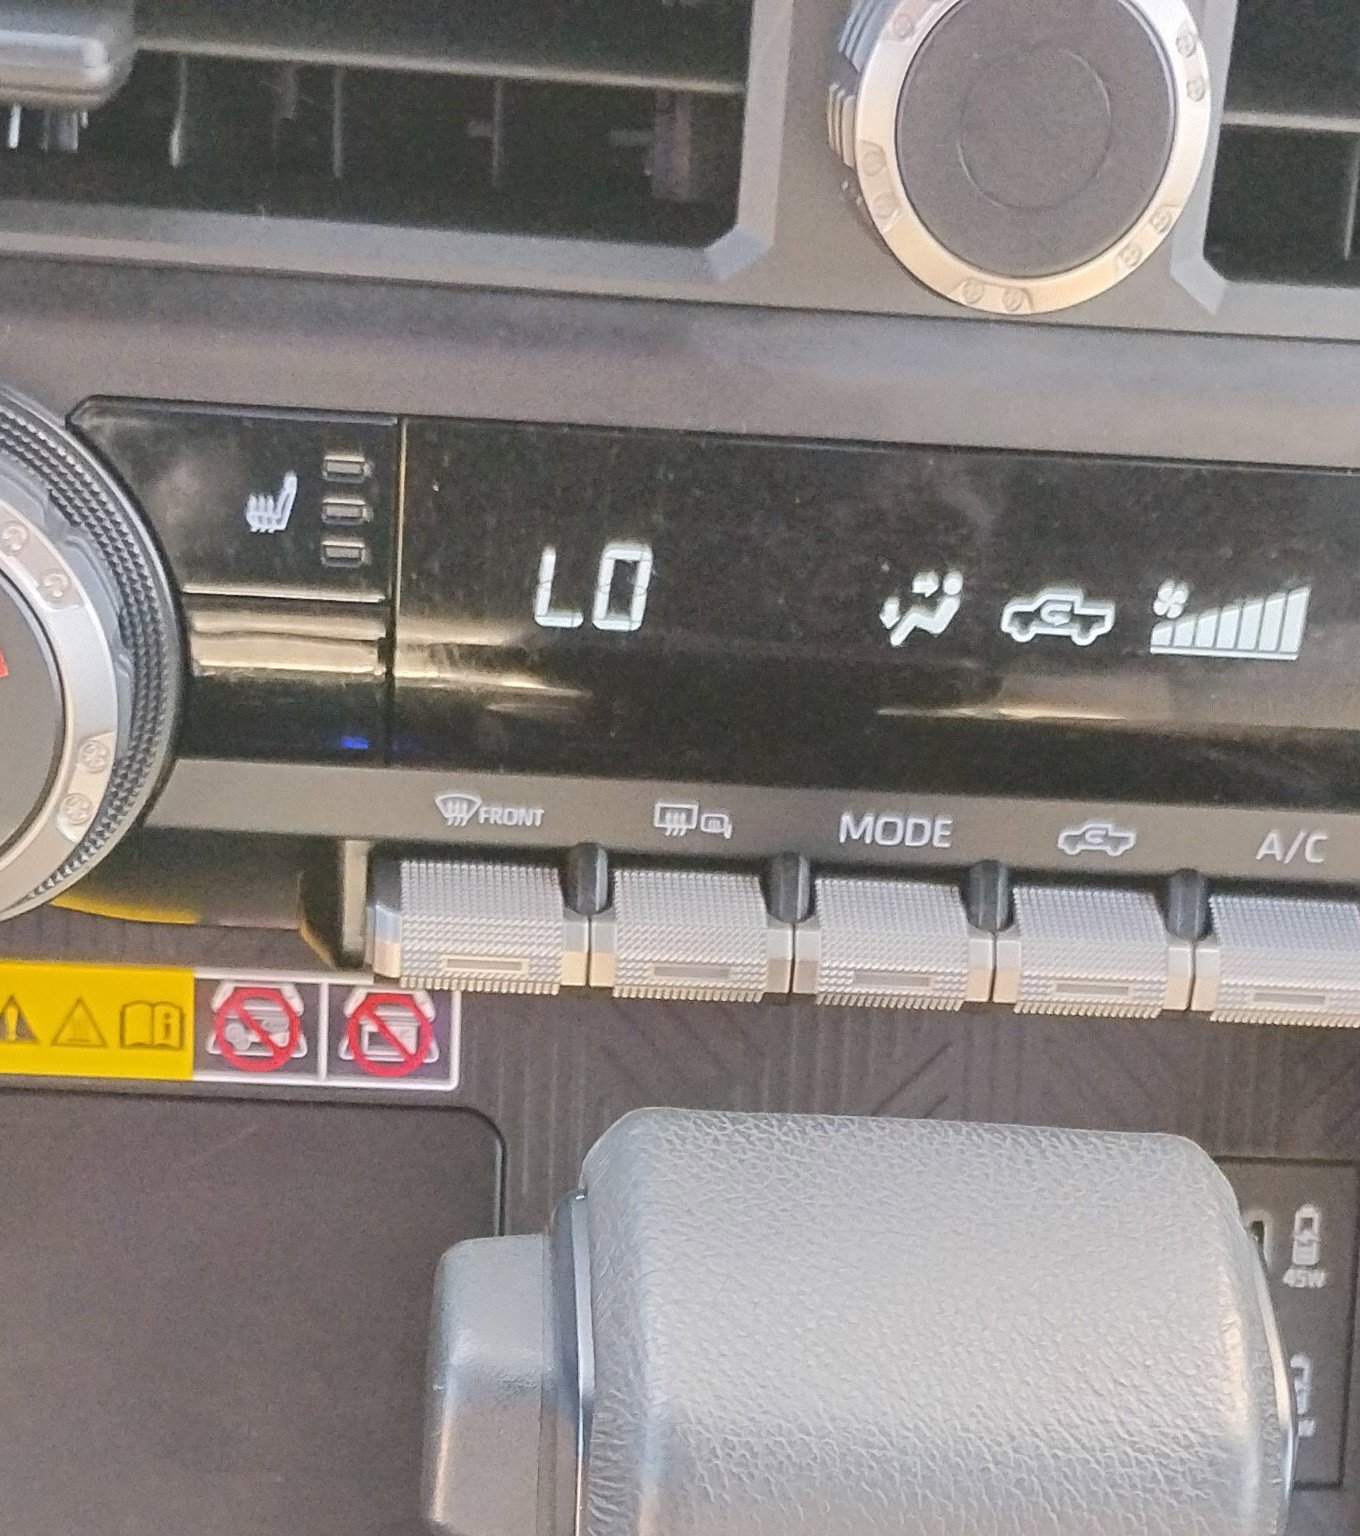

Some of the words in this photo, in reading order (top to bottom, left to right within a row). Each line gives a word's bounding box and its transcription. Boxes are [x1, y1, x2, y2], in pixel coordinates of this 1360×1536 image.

[534, 541, 654, 632] LO
[478, 806, 545, 827] FRONT
[839, 810, 953, 849] MODE
[1255, 829, 1330, 865] A/C
[1282, 1267, 1327, 1289] 45W
